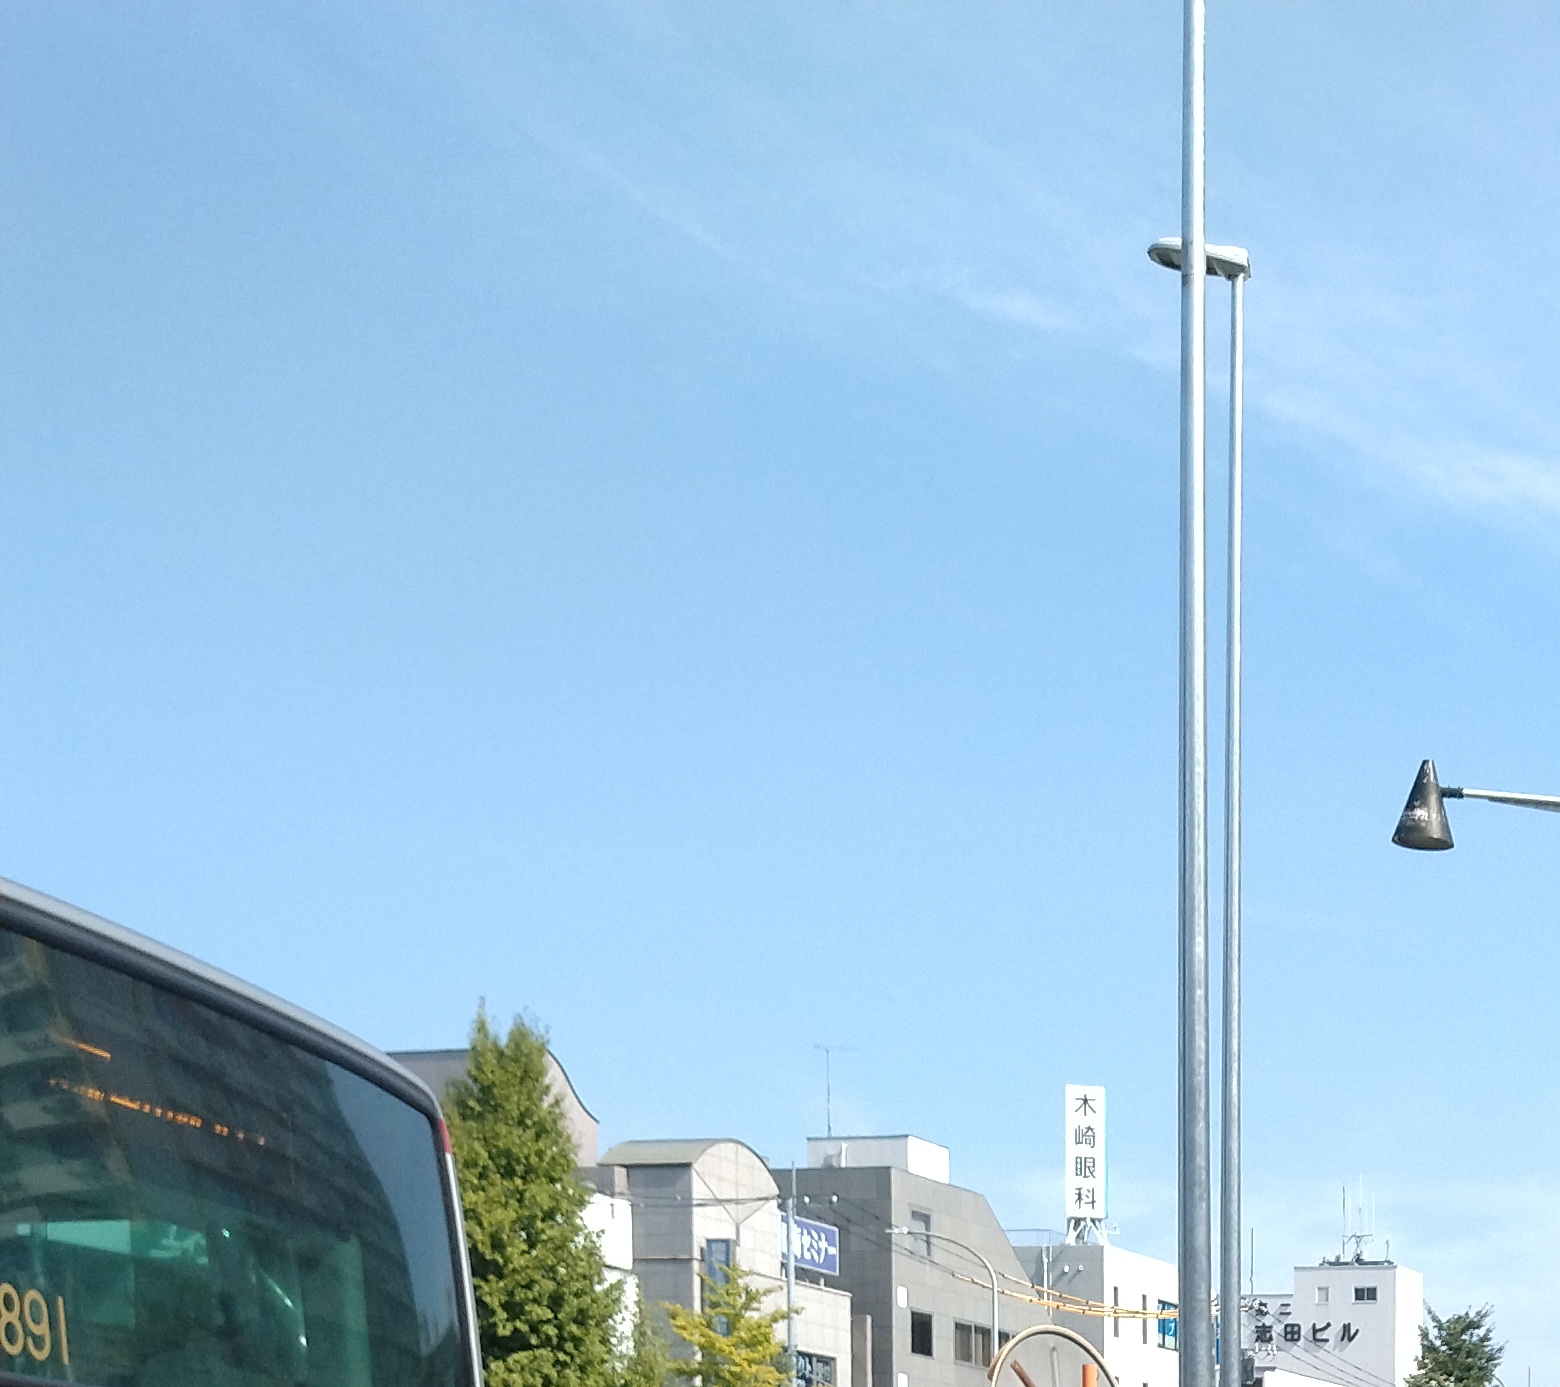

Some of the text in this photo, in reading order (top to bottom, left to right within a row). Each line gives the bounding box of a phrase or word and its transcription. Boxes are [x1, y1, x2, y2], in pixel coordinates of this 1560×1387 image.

[1074, 1093, 1097, 1211] 木崎眼科
[1253, 1321, 1360, 1343] 志田ビル
